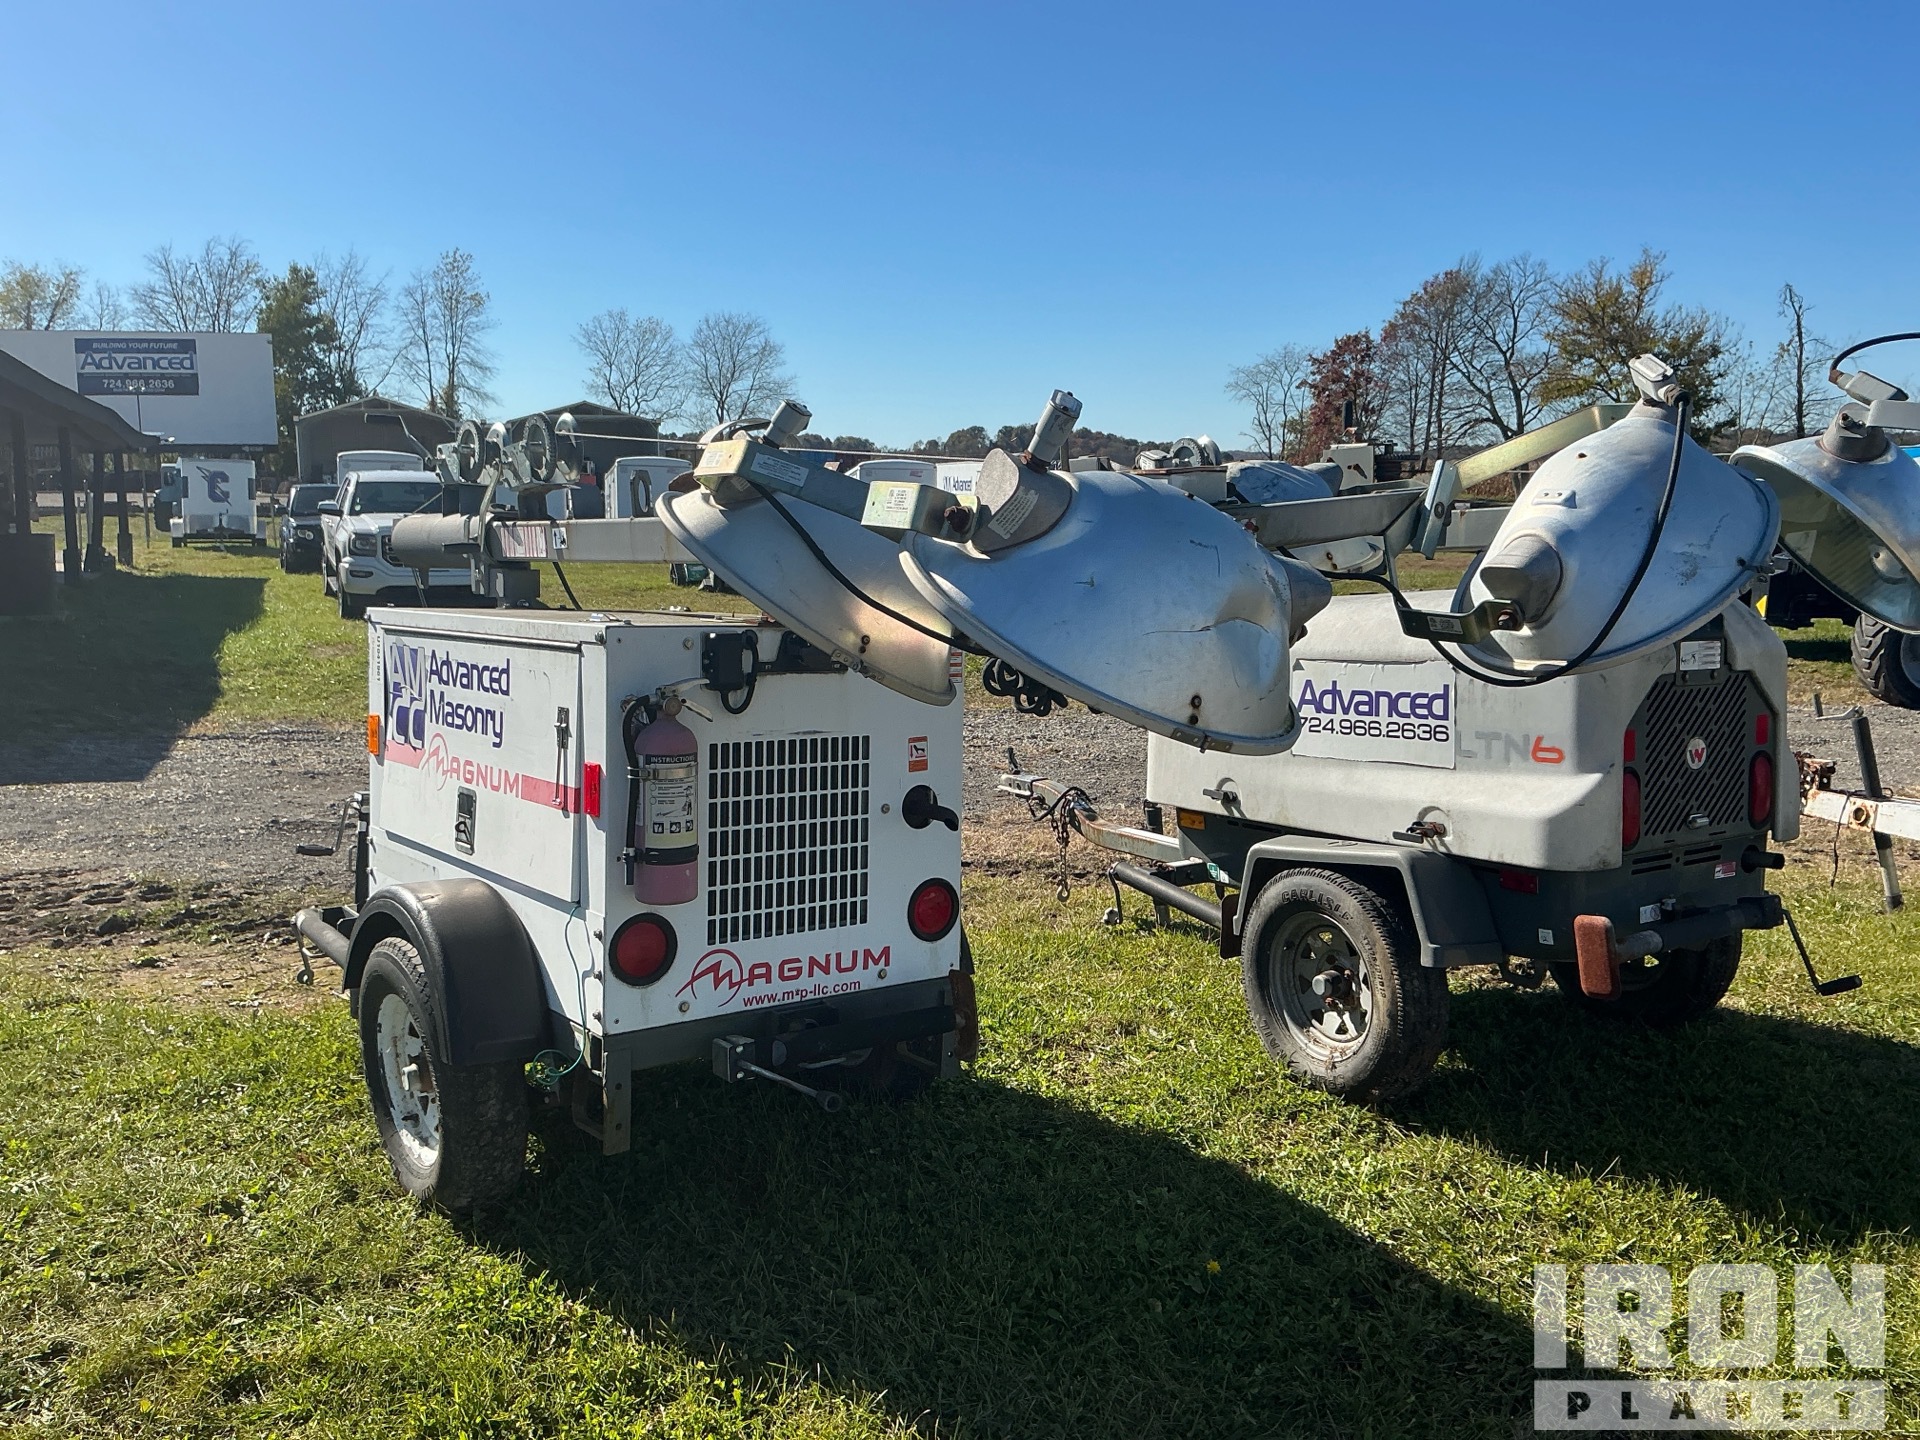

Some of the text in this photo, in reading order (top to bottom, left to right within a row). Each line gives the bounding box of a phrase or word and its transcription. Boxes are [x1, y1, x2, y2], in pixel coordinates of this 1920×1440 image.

[80, 351, 195, 370] Advanced
[428, 649, 511, 697] Advanced
[429, 689, 504, 748] Masonry
[1297, 679, 1450, 722] Advanced
[1299, 716, 1450, 743] 724.966.2636
[1458, 731, 1566, 765] LTN6
[421, 733, 521, 798] MAGNUM
[1281, 888, 1354, 922] CARLISLE
[675, 946, 891, 1007] MAGNUM
